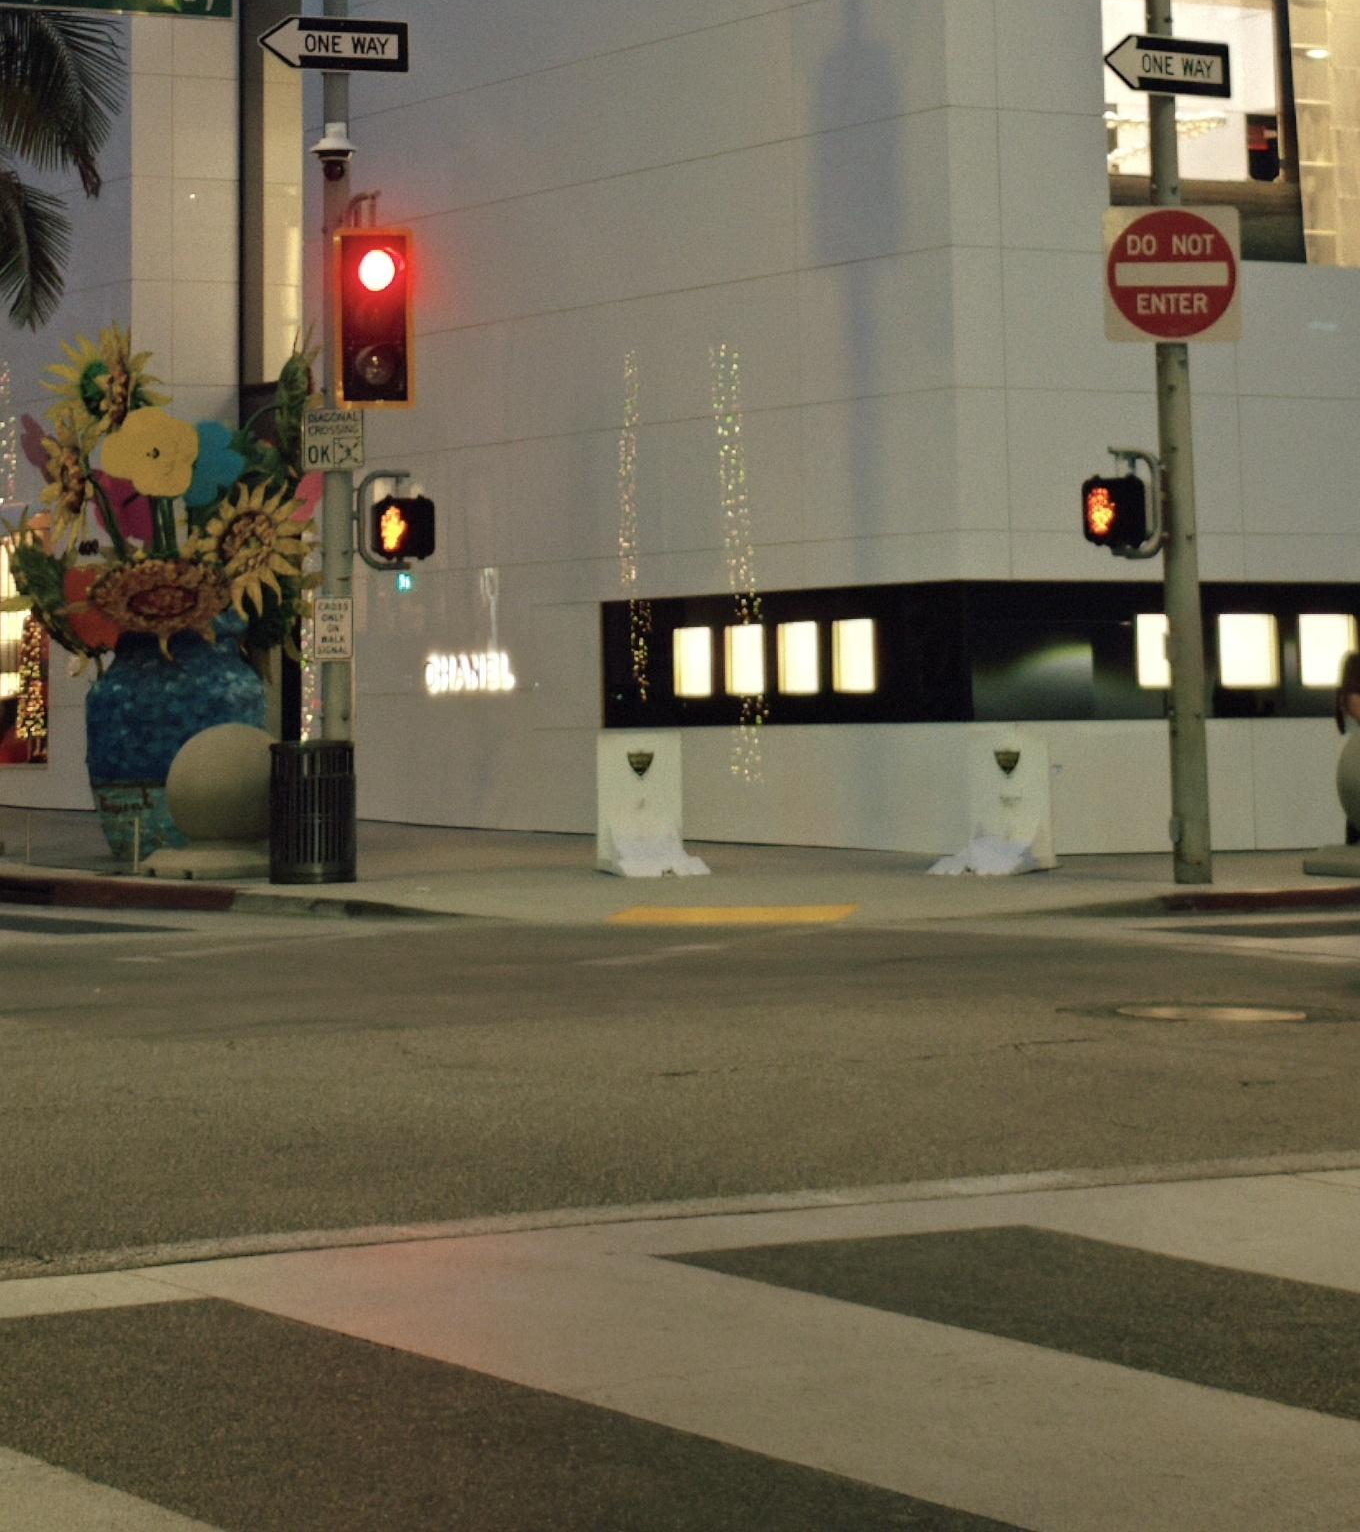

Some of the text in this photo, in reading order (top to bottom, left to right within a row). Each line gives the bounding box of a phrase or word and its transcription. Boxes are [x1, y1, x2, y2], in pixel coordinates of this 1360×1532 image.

[305, 33, 390, 56] ONE WAY
[1142, 53, 1215, 78] ONE WAY
[1126, 232, 1216, 256] DO NOT
[1136, 292, 1209, 315] ENTER
[308, 444, 331, 465] OK
[425, 652, 516, 694] CHANEL
